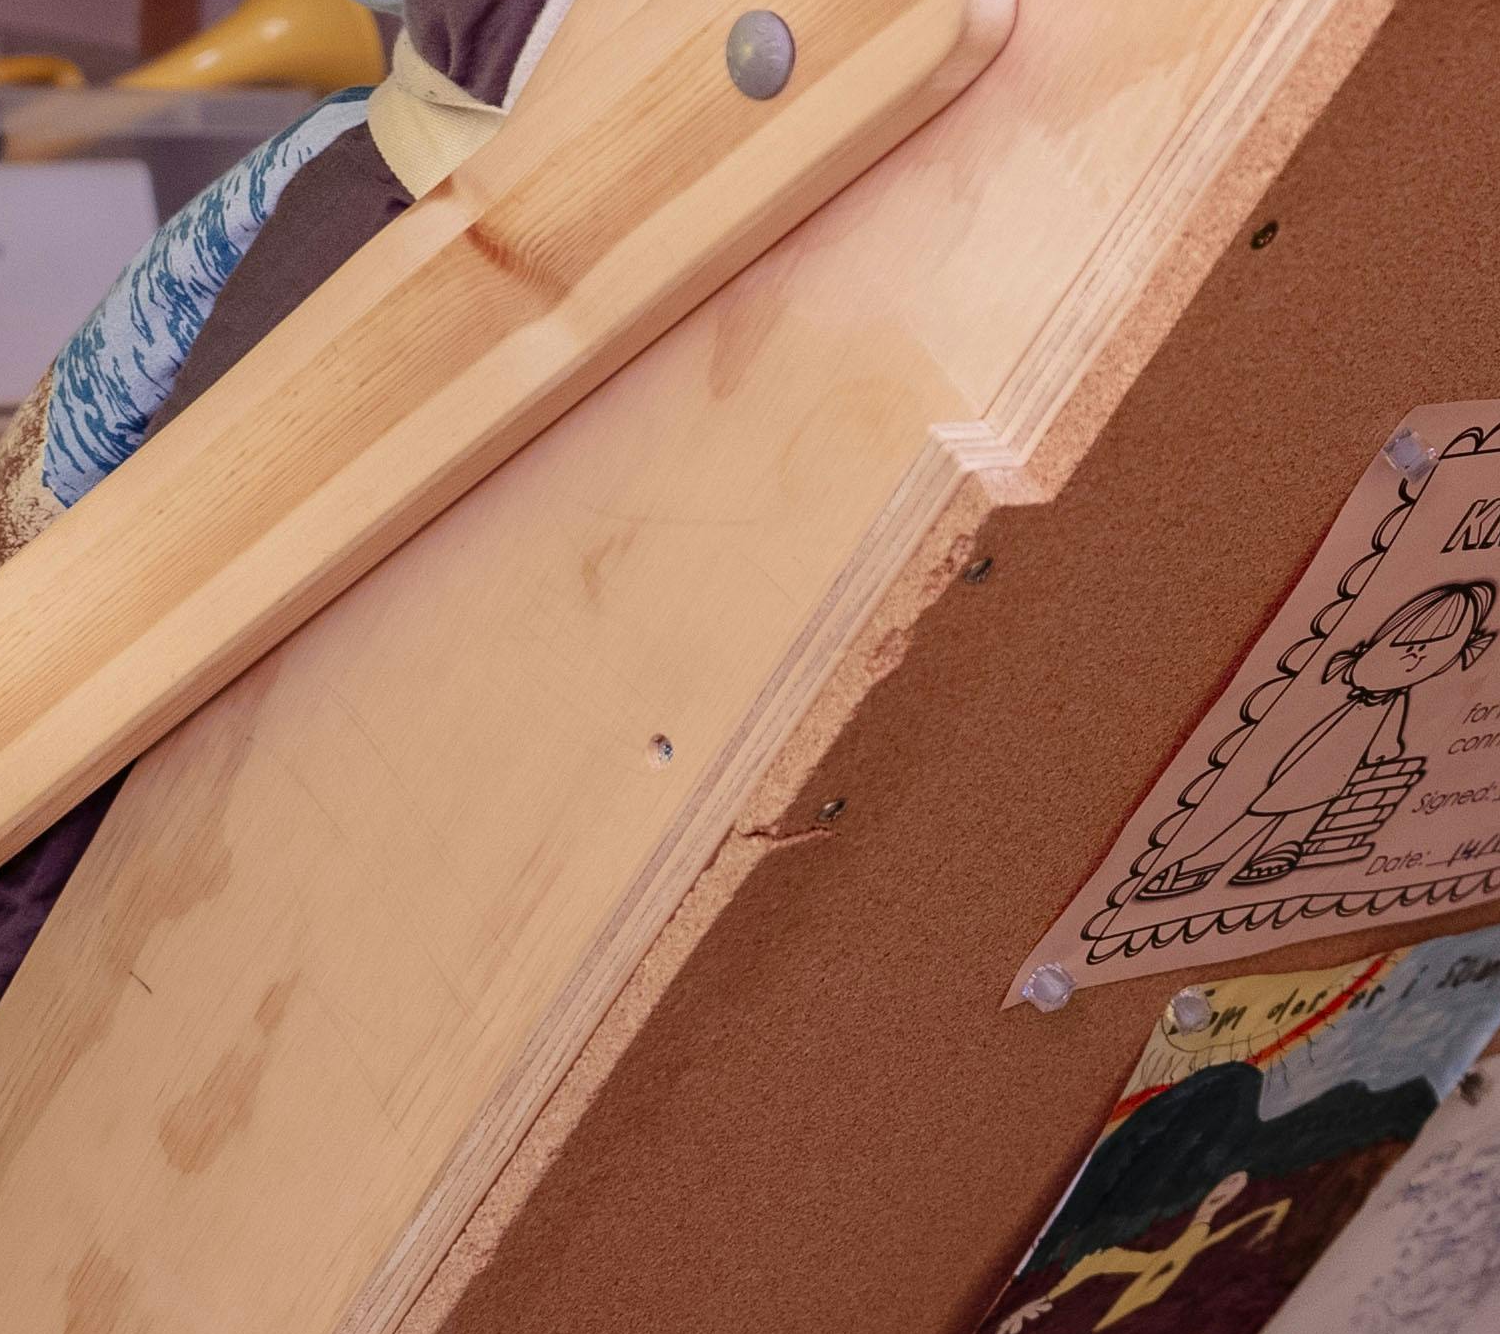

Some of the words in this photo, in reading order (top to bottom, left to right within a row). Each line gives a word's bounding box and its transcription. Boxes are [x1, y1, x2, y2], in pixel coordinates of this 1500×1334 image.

[1463, 702, 1499, 725] for
[1412, 781, 1498, 815] Signed:
[1365, 850, 1431, 876] Date:
